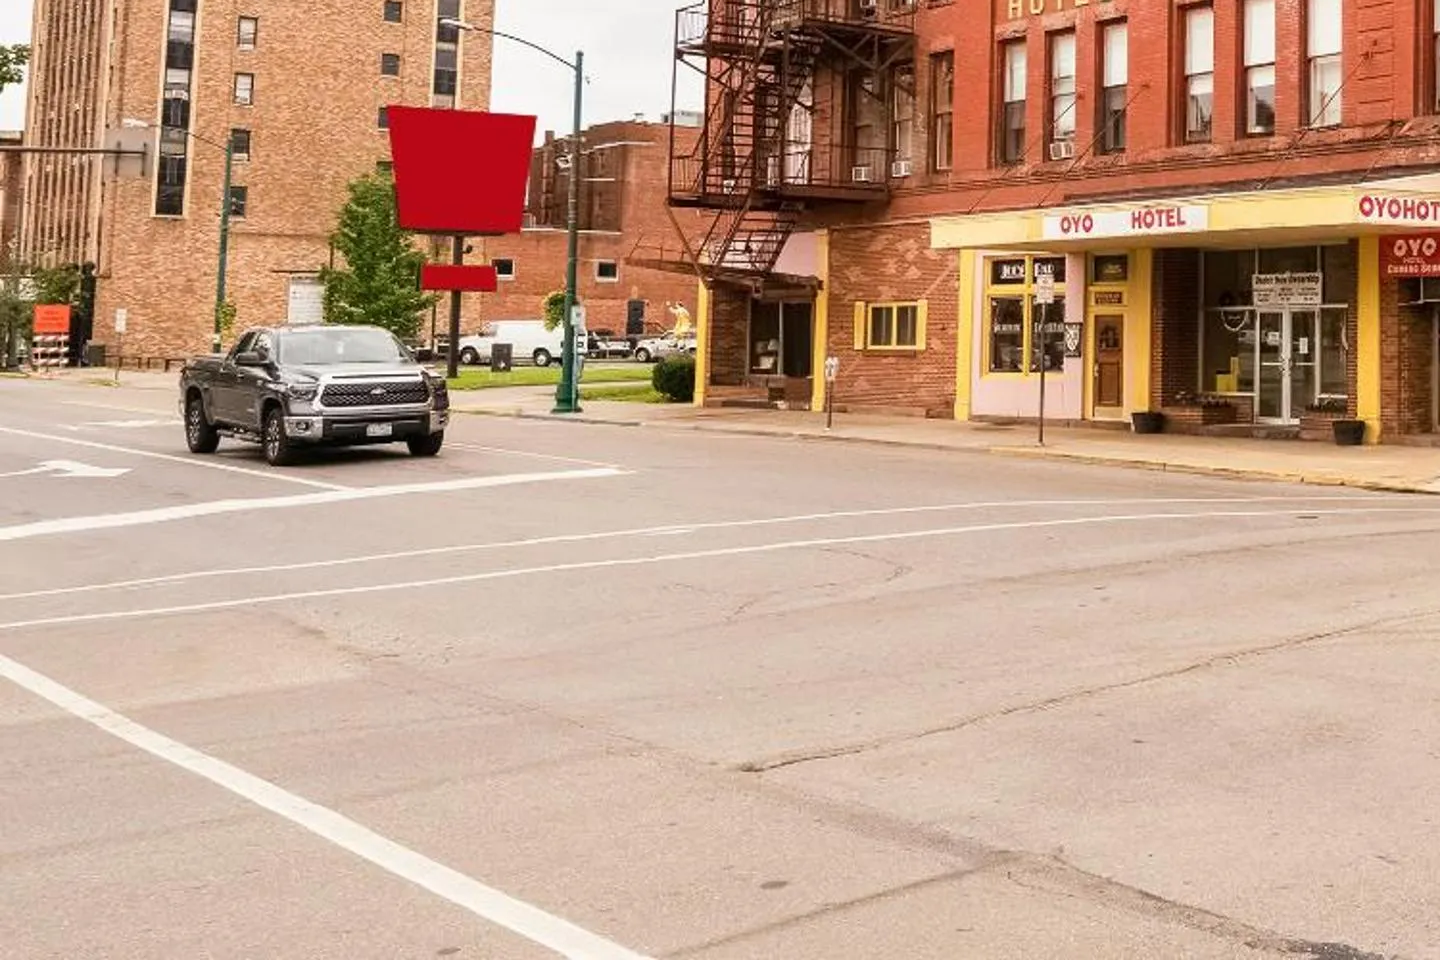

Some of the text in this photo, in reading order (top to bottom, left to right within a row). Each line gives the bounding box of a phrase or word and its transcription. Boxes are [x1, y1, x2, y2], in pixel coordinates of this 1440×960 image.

[1060, 207, 1186, 234] OYO HOTEL
[1393, 238, 1437, 256] OYO
